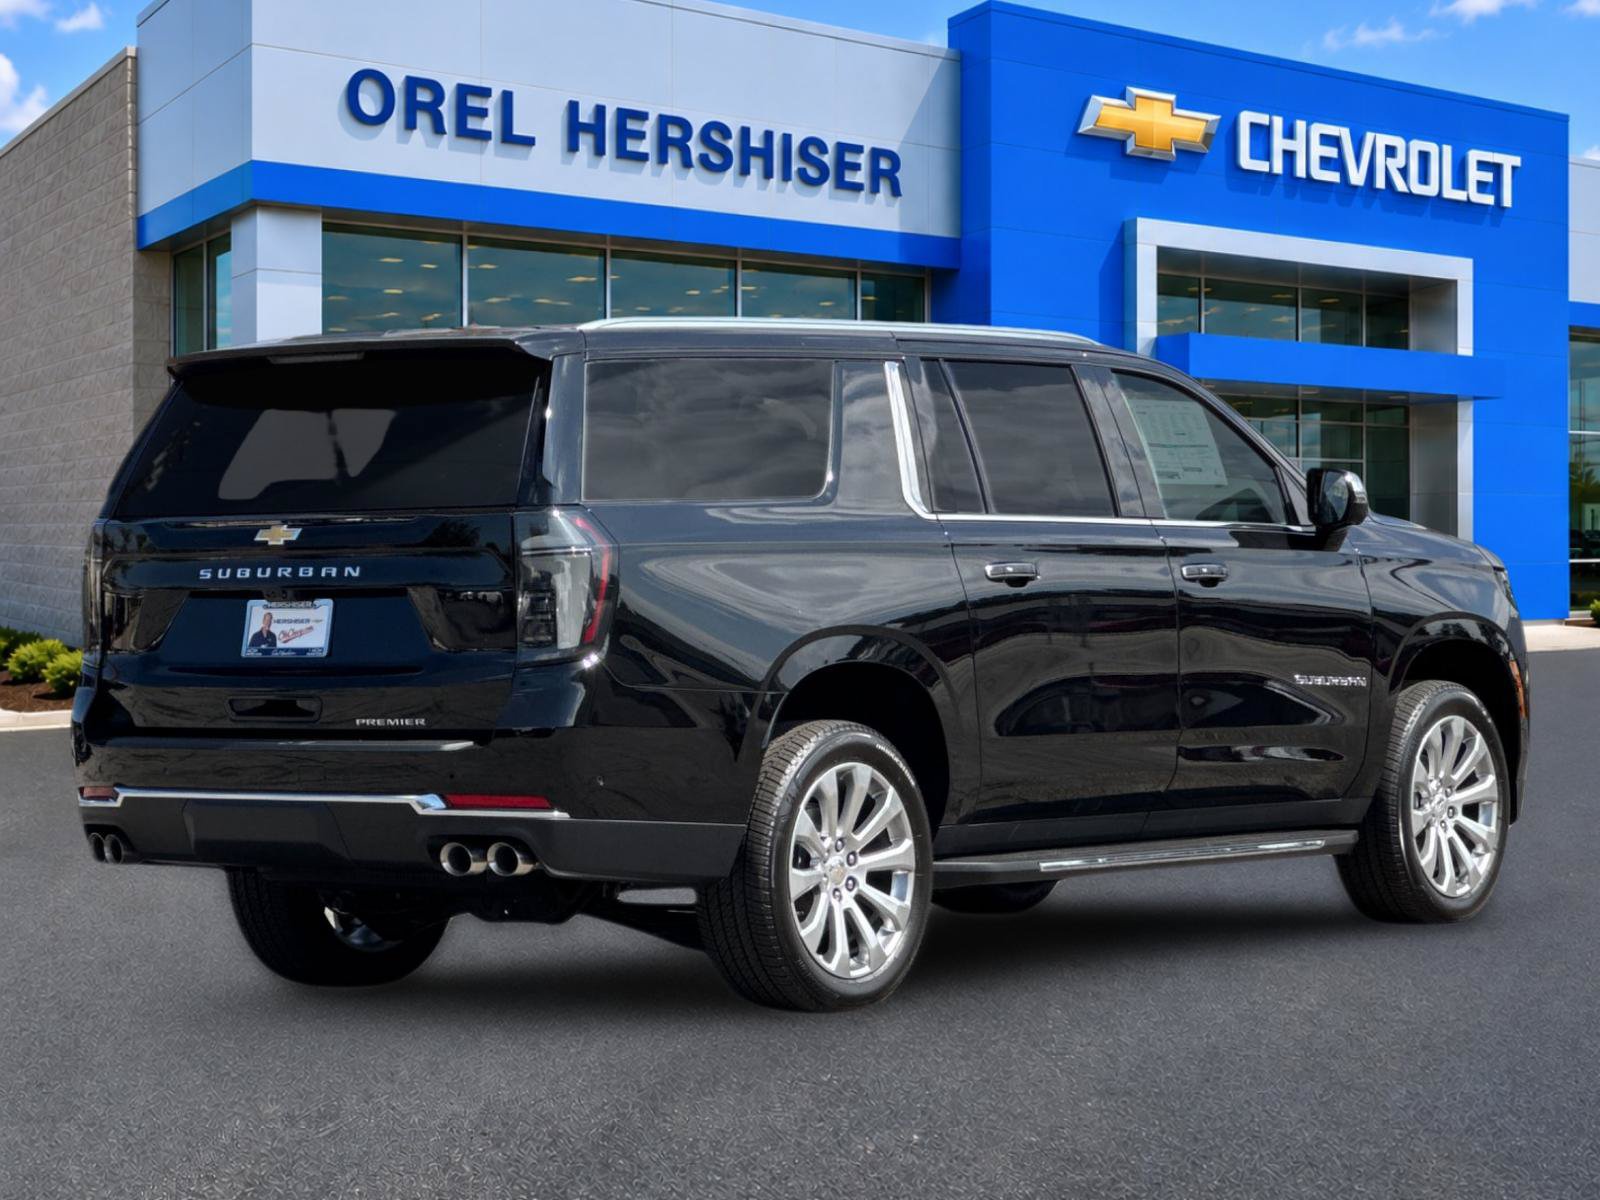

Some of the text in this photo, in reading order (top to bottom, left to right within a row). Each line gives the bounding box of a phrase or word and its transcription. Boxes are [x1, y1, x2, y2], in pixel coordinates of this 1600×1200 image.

[346, 68, 902, 197] OREL HERSHISER
[1236, 109, 1522, 208] CHEVROLET
[199, 565, 362, 580] SUBURBAN
[1294, 674, 1367, 687] SUBURBAN
[355, 718, 427, 727] PREMIER
